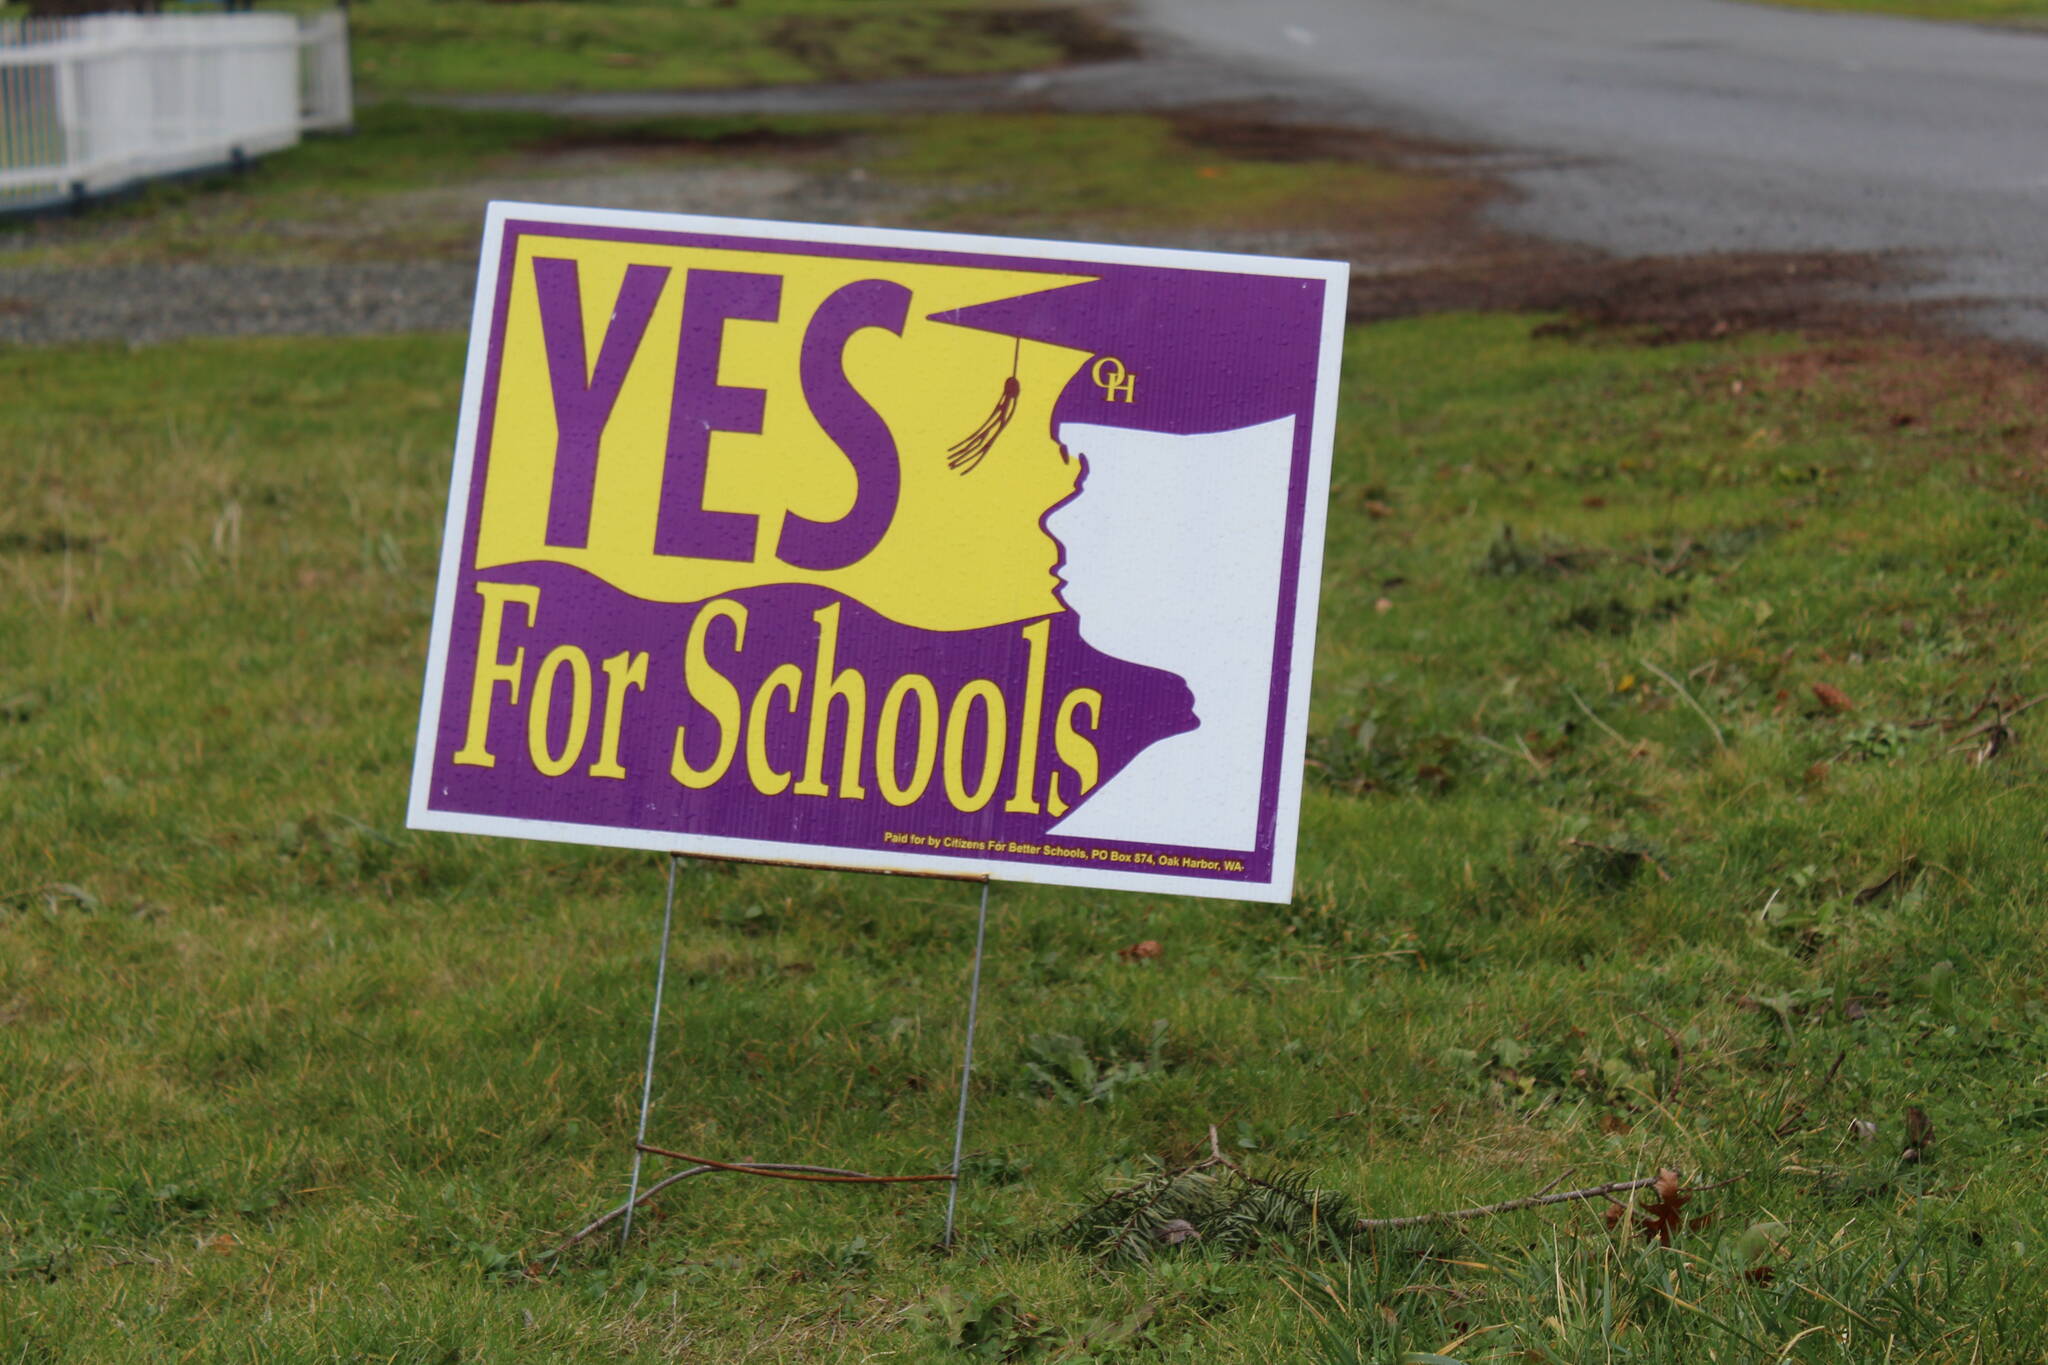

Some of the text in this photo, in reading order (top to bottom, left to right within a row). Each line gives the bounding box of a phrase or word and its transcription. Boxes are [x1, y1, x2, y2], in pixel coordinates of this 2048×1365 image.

[532, 256, 914, 571] YES
[452, 581, 1103, 819] For Schools
[884, 831, 908, 844] Paid
[910, 834, 925, 845] for
[928, 835, 941, 848] by
[943, 837, 985, 850] Citizens
[988, 840, 1006, 852] For
[1009, 842, 1042, 855] Better
[1043, 844, 1089, 860] Schools,
[1091, 849, 1108, 860] PO
[1110, 851, 1131, 862] Box
[1158, 855, 1180, 867] Oak
[1182, 858, 1221, 871] Harbor,
